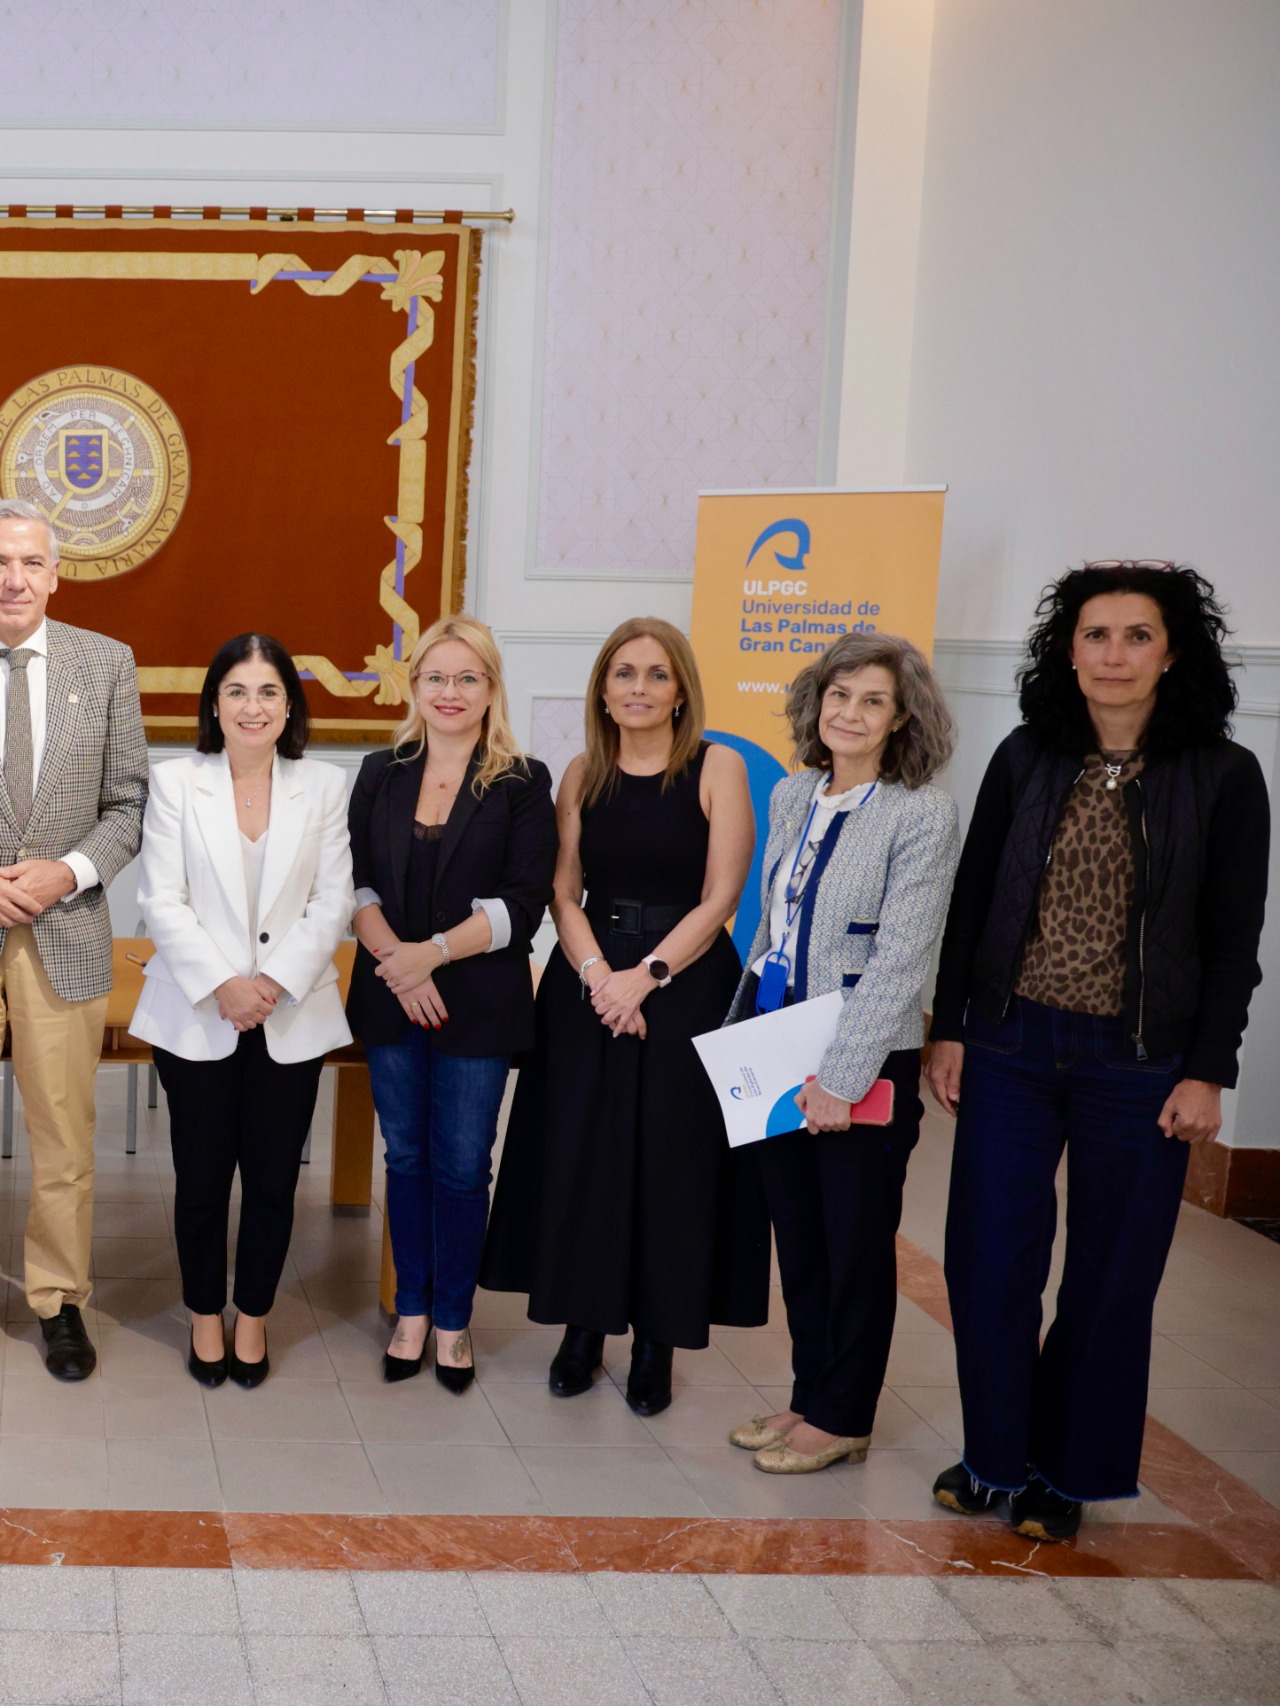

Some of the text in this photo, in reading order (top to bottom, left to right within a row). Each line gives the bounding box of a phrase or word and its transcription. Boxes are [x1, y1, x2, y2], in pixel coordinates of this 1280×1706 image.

[57, 369, 142, 398] PALMAS
[147, 398, 172, 426] DE
[167, 433, 187, 500] GRAN
[94, 507, 179, 576] CANARIA
[743, 580, 808, 596] ULPGC
[742, 599, 880, 616] Universidad de
[741, 618, 773, 633] Las
[778, 618, 848, 635] Palmas
[739, 637, 785, 652] Gran
